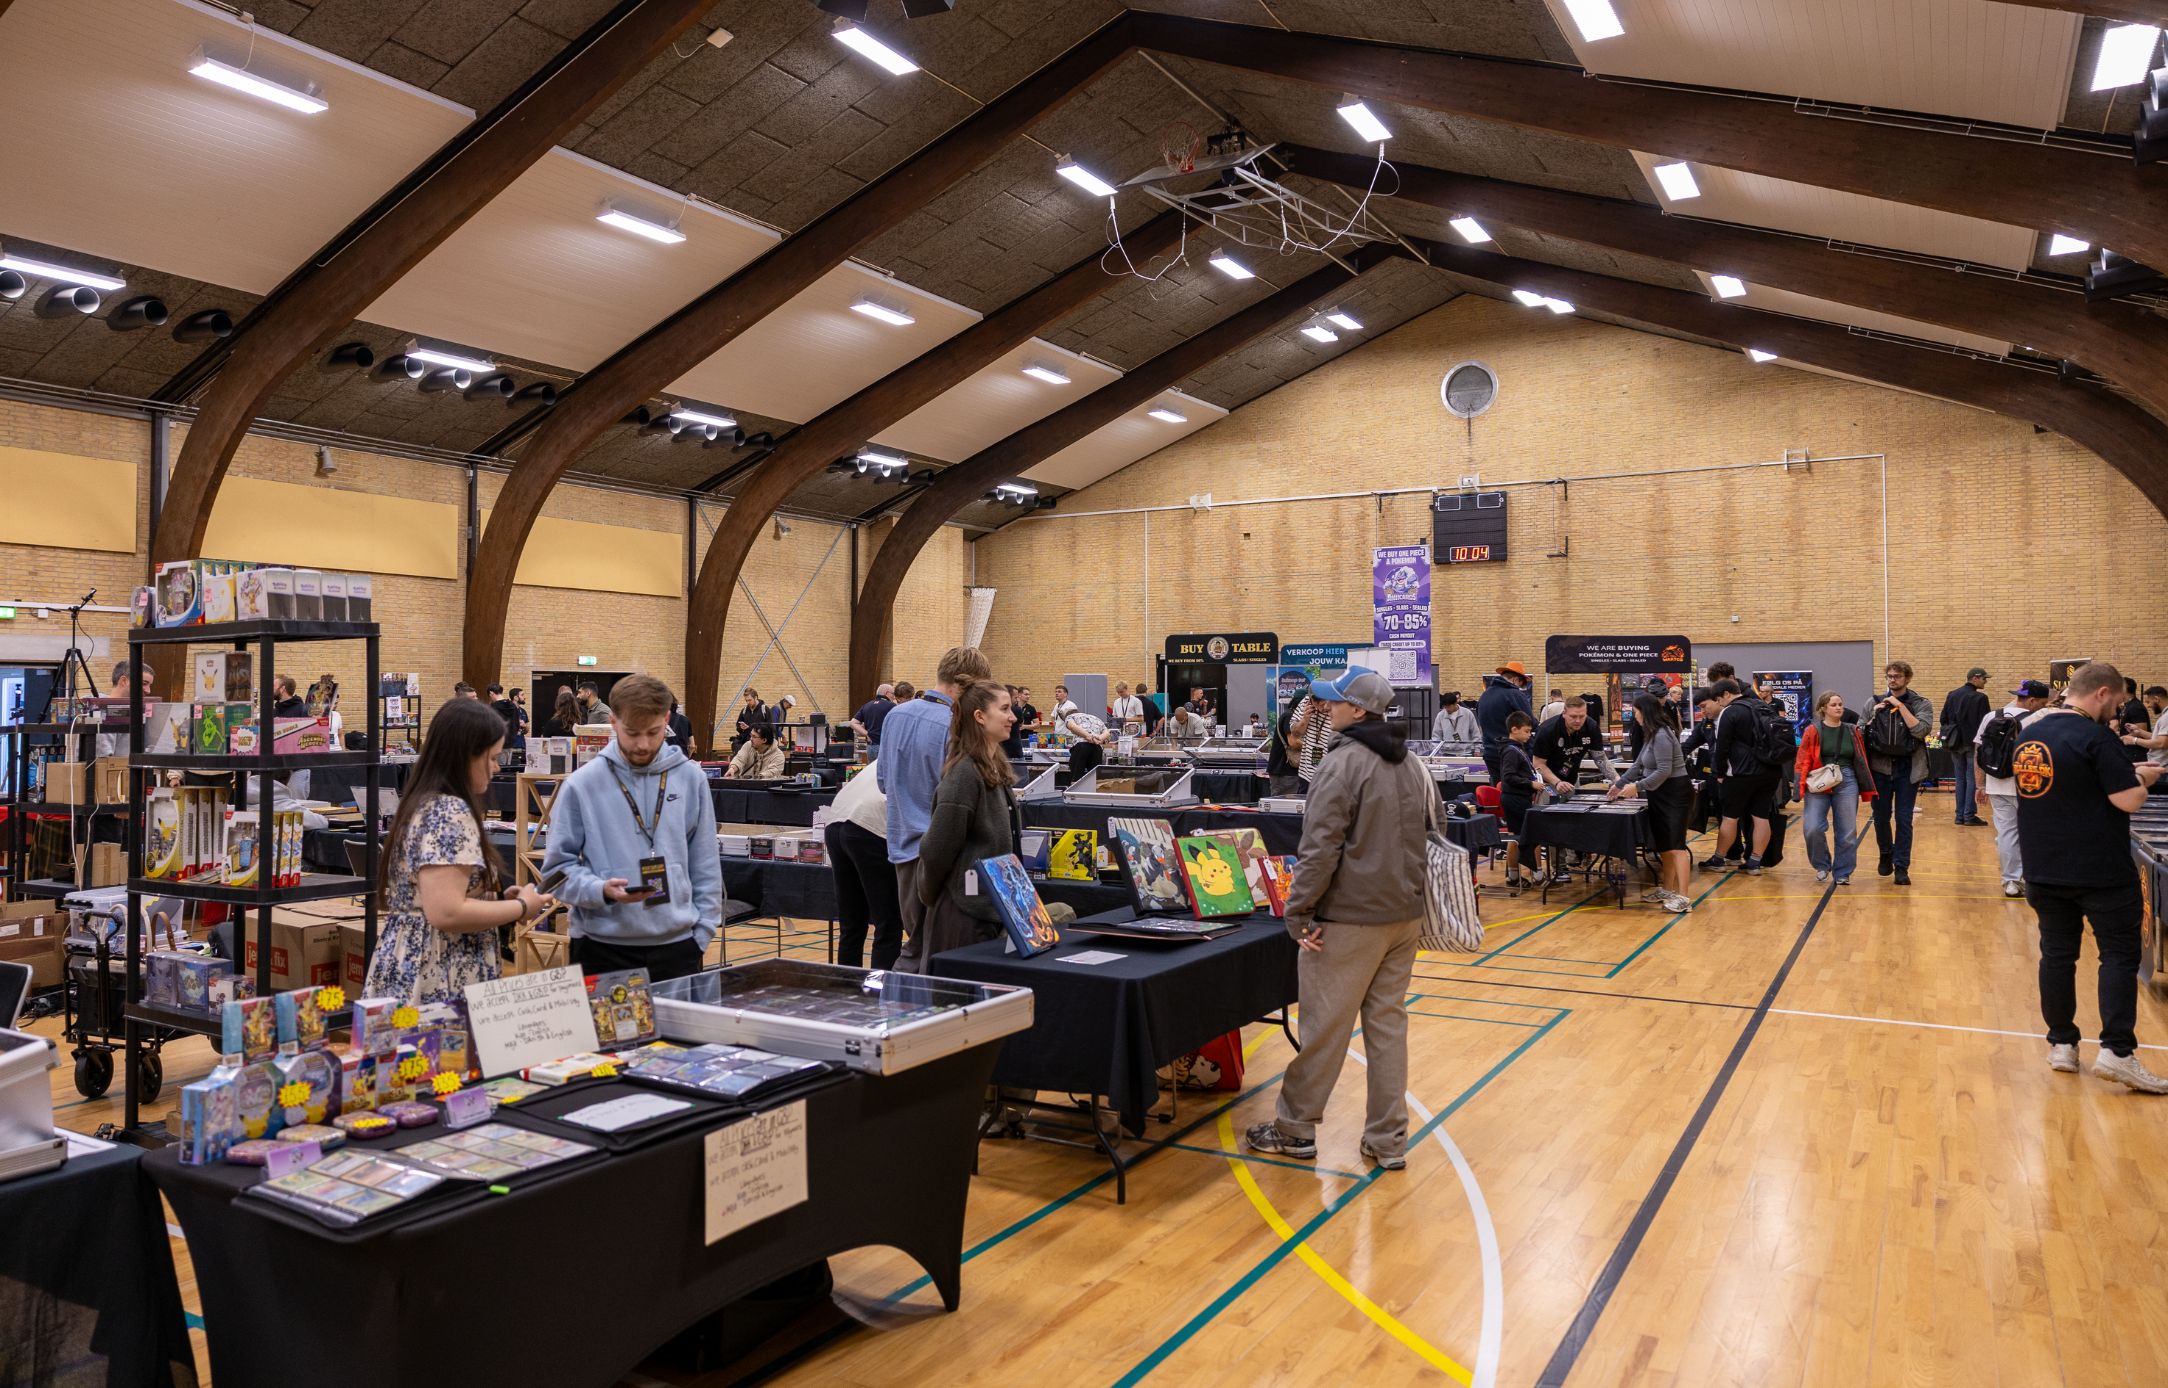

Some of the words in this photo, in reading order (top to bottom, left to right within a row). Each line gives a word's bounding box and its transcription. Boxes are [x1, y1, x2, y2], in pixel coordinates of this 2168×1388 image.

[1456, 548, 1468, 560] 10
[1472, 547, 1488, 558] 04
[1384, 614, 1428, 630] 70-85%
[1180, 644, 1204, 653] BUY
[1232, 642, 1270, 652] TABLE
[2053, 680, 2070, 690] SLA
[404, 1060, 423, 1074] 175
